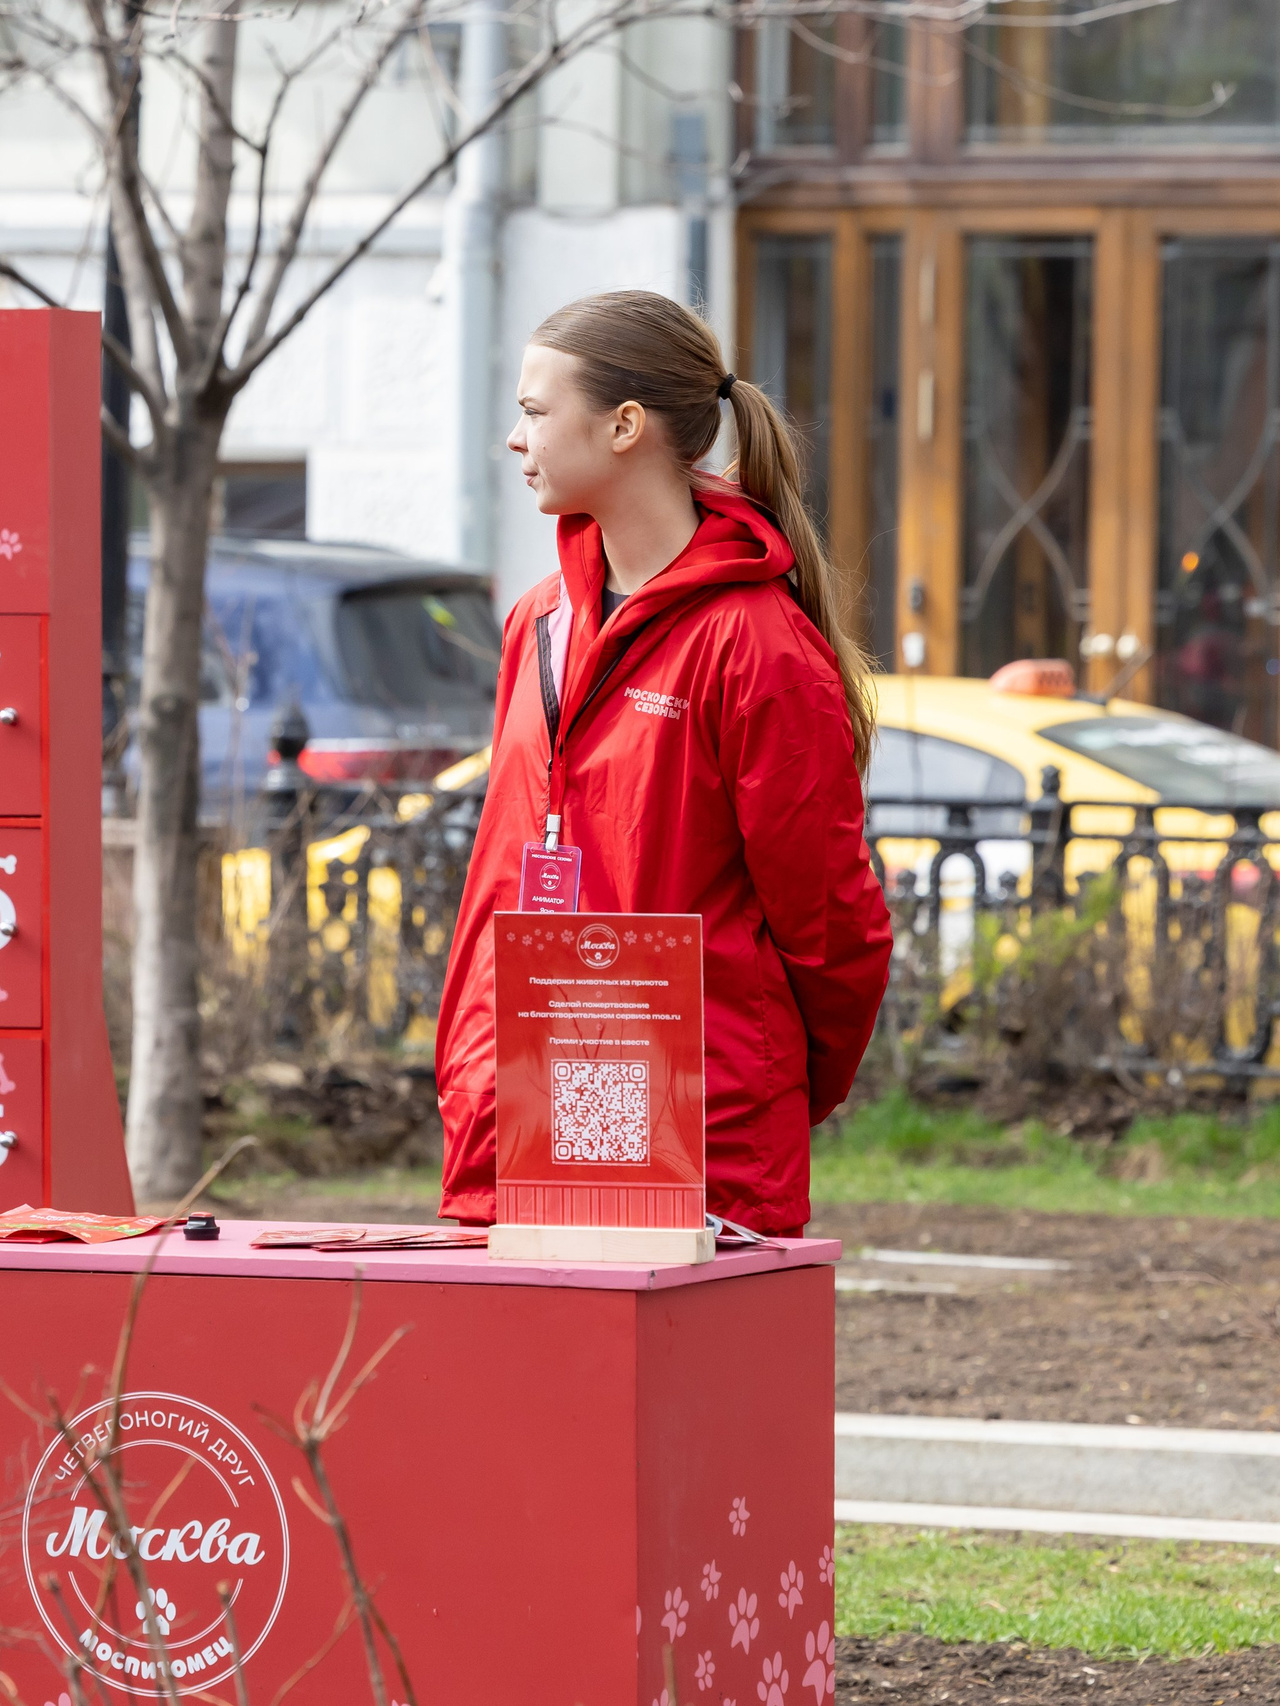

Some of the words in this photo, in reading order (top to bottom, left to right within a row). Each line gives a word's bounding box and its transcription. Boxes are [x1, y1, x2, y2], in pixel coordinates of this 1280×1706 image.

[634, 701, 681, 720] СЕЗОНЫ
[532, 895, 565, 905] АНИМАТОР
[529, 977, 574, 985] Поддержи
[548, 1000, 581, 1008] Сделай
[530, 1010, 614, 1019] благотворительном
[549, 1037, 578, 1045] Прими
[578, 1038, 613, 1046] участие
[207, 1437, 255, 1488] ДРУГ
[46, 1506, 265, 1566] Москва
[78, 1628, 235, 1680] МОСПИТОМЕЦ
